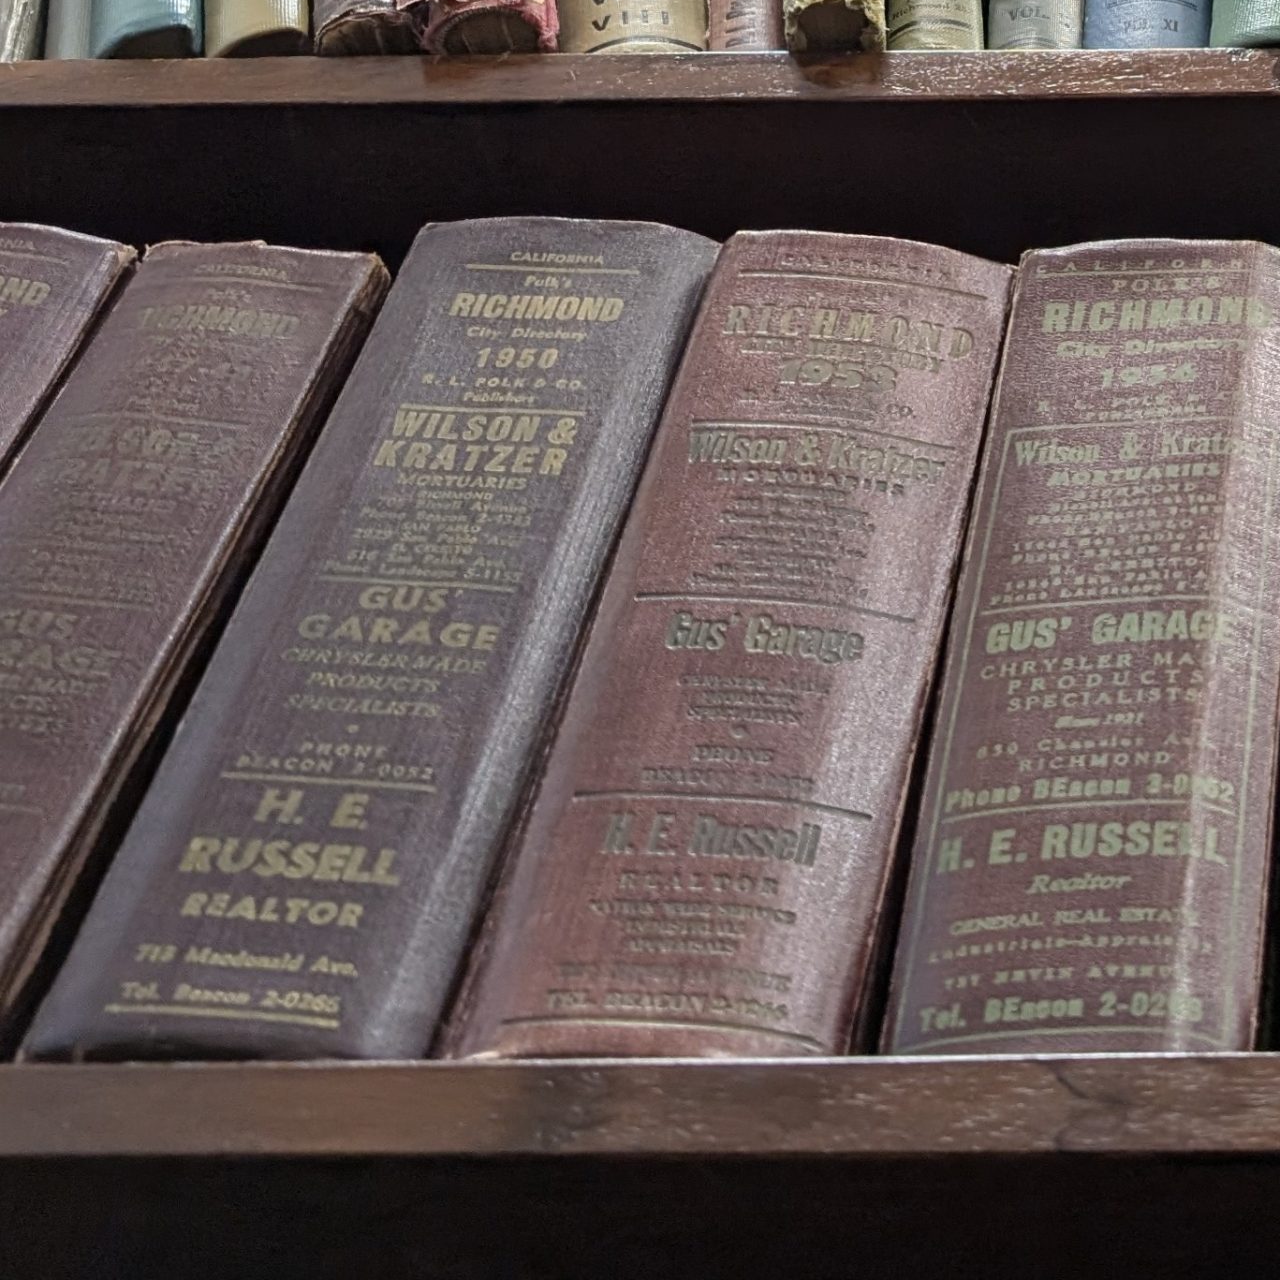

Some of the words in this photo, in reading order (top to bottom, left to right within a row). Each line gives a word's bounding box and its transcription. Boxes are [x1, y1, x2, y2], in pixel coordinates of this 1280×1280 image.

[590, 9, 670, 33] VIII
[510, 251, 605, 265] CALIFORNIA
[448, 292, 625, 322] RICHMOND
[1041, 295, 1274, 333] RICHMOND
[466, 325, 501, 340] City
[722, 303, 976, 359] RICHMOND
[475, 347, 560, 370] 1950
[474, 376, 528, 389] POLK
[392, 409, 539, 443] WILSON
[547, 418, 579, 446] &
[374, 439, 568, 476] KRATZER
[688, 428, 787, 465] Wilson
[799, 433, 821, 466] &
[827, 433, 946, 485] Kratzer
[1014, 440, 1101, 466] Wilson
[397, 472, 528, 491] MORTUARIES
[358, 586, 464, 611] GUS'
[298, 614, 500, 650] GARAGE
[745, 614, 866, 664] Garage
[986, 616, 1072, 654] GUS'
[1092, 610, 1238, 646] GARAGE
[980, 652, 1133, 680] CHRYSLER
[1008, 670, 1204, 695] PRODUCTS
[1006, 688, 1202, 712] SPECIALISTS
[299, 742, 388, 758] PHONE
[1018, 751, 1171, 772] RICHMOND
[253, 788, 304, 824] H.
[328, 792, 370, 830] E.
[687, 815, 823, 868] Russell
[937, 837, 976, 874] H.
[988, 828, 1027, 865] E.
[1041, 822, 1229, 866] RUSSELL
[178, 836, 400, 886] RUSSELL
[617, 871, 780, 896] REALTOR
[1027, 874, 1133, 896] Realtor
[180, 892, 364, 928] REALTOR
